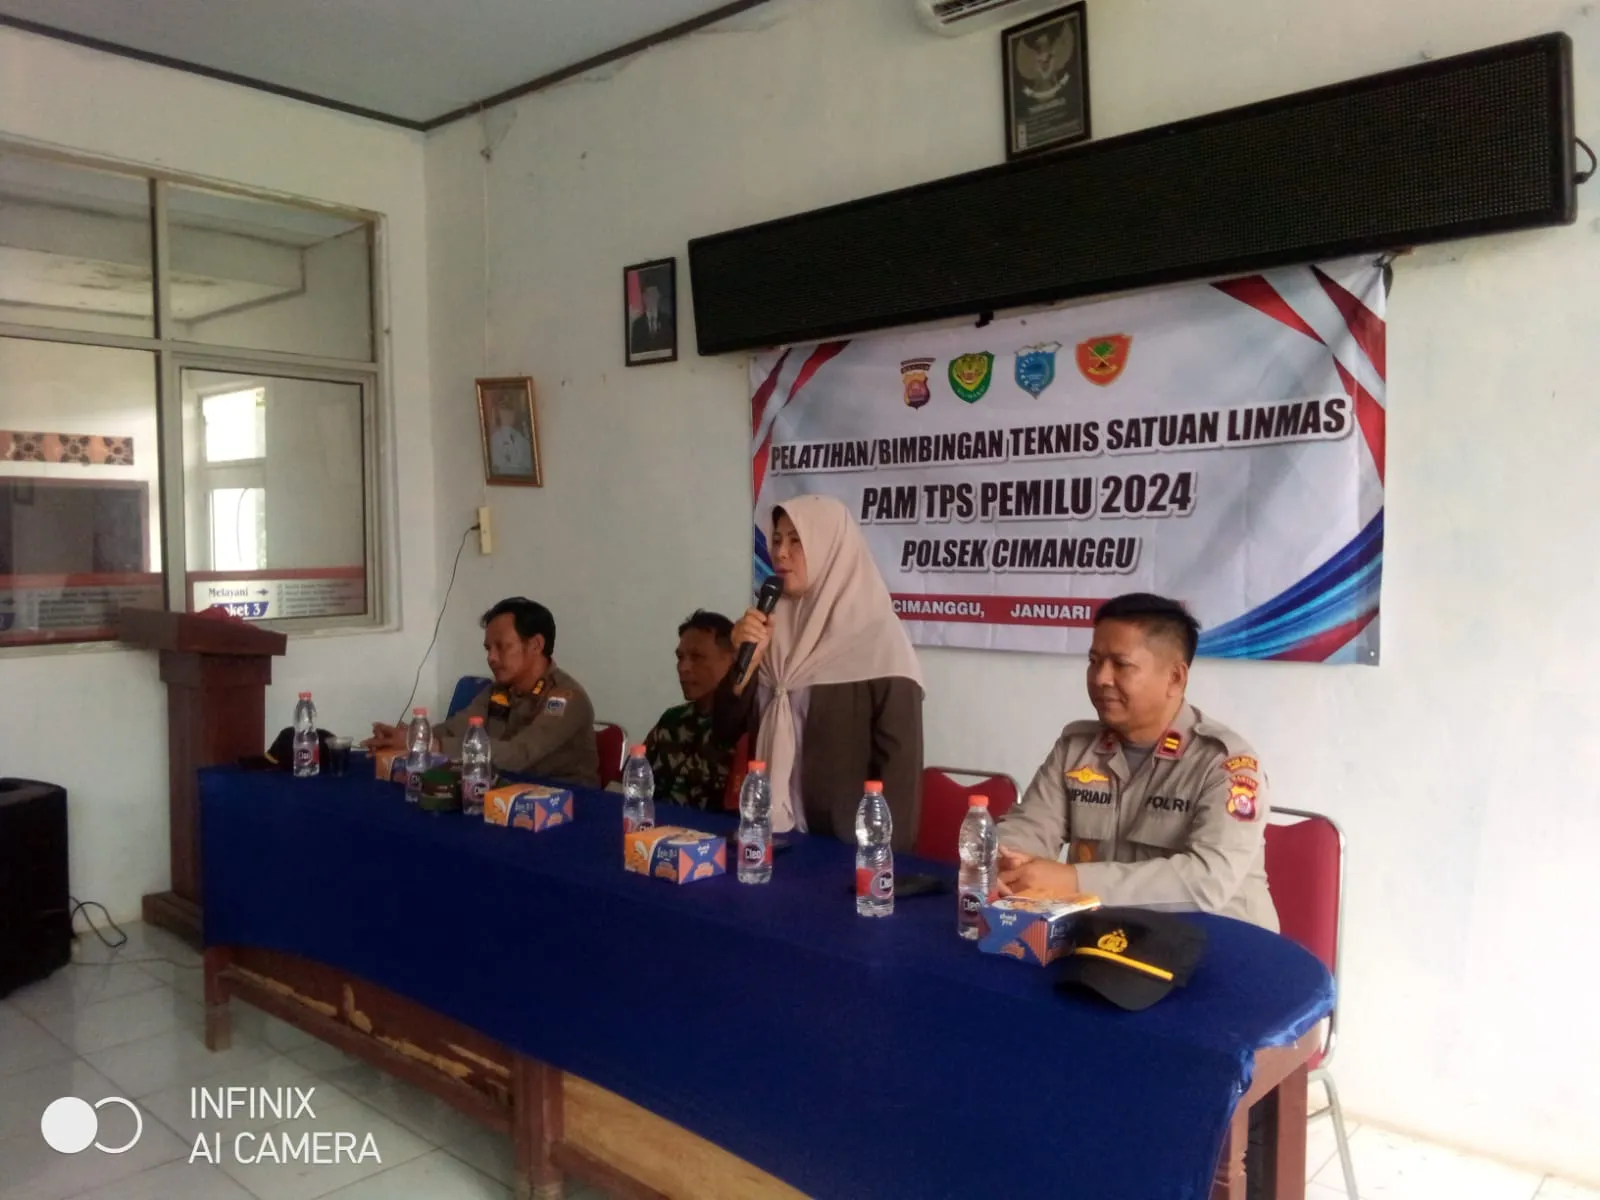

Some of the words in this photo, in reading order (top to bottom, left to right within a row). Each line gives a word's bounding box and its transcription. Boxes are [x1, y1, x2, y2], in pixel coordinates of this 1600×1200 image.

[771, 429, 1003, 470] PELATIHAN/BIMBINGAN
[1010, 421, 1099, 456] TEKNIS
[1106, 411, 1219, 450] SATUAN
[1227, 398, 1346, 441] LINMAS
[861, 486, 917, 520] PAM
[923, 483, 973, 518] TPS
[980, 477, 1092, 517] PEMILU
[1101, 472, 1192, 513] 2024
[901, 539, 988, 570] POLSEK
[991, 537, 1136, 568] CIMANGGU
[253, 604, 260, 615] 3
[892, 600, 985, 618] CIMANGGU,
[1010, 604, 1090, 620] JANUARI
